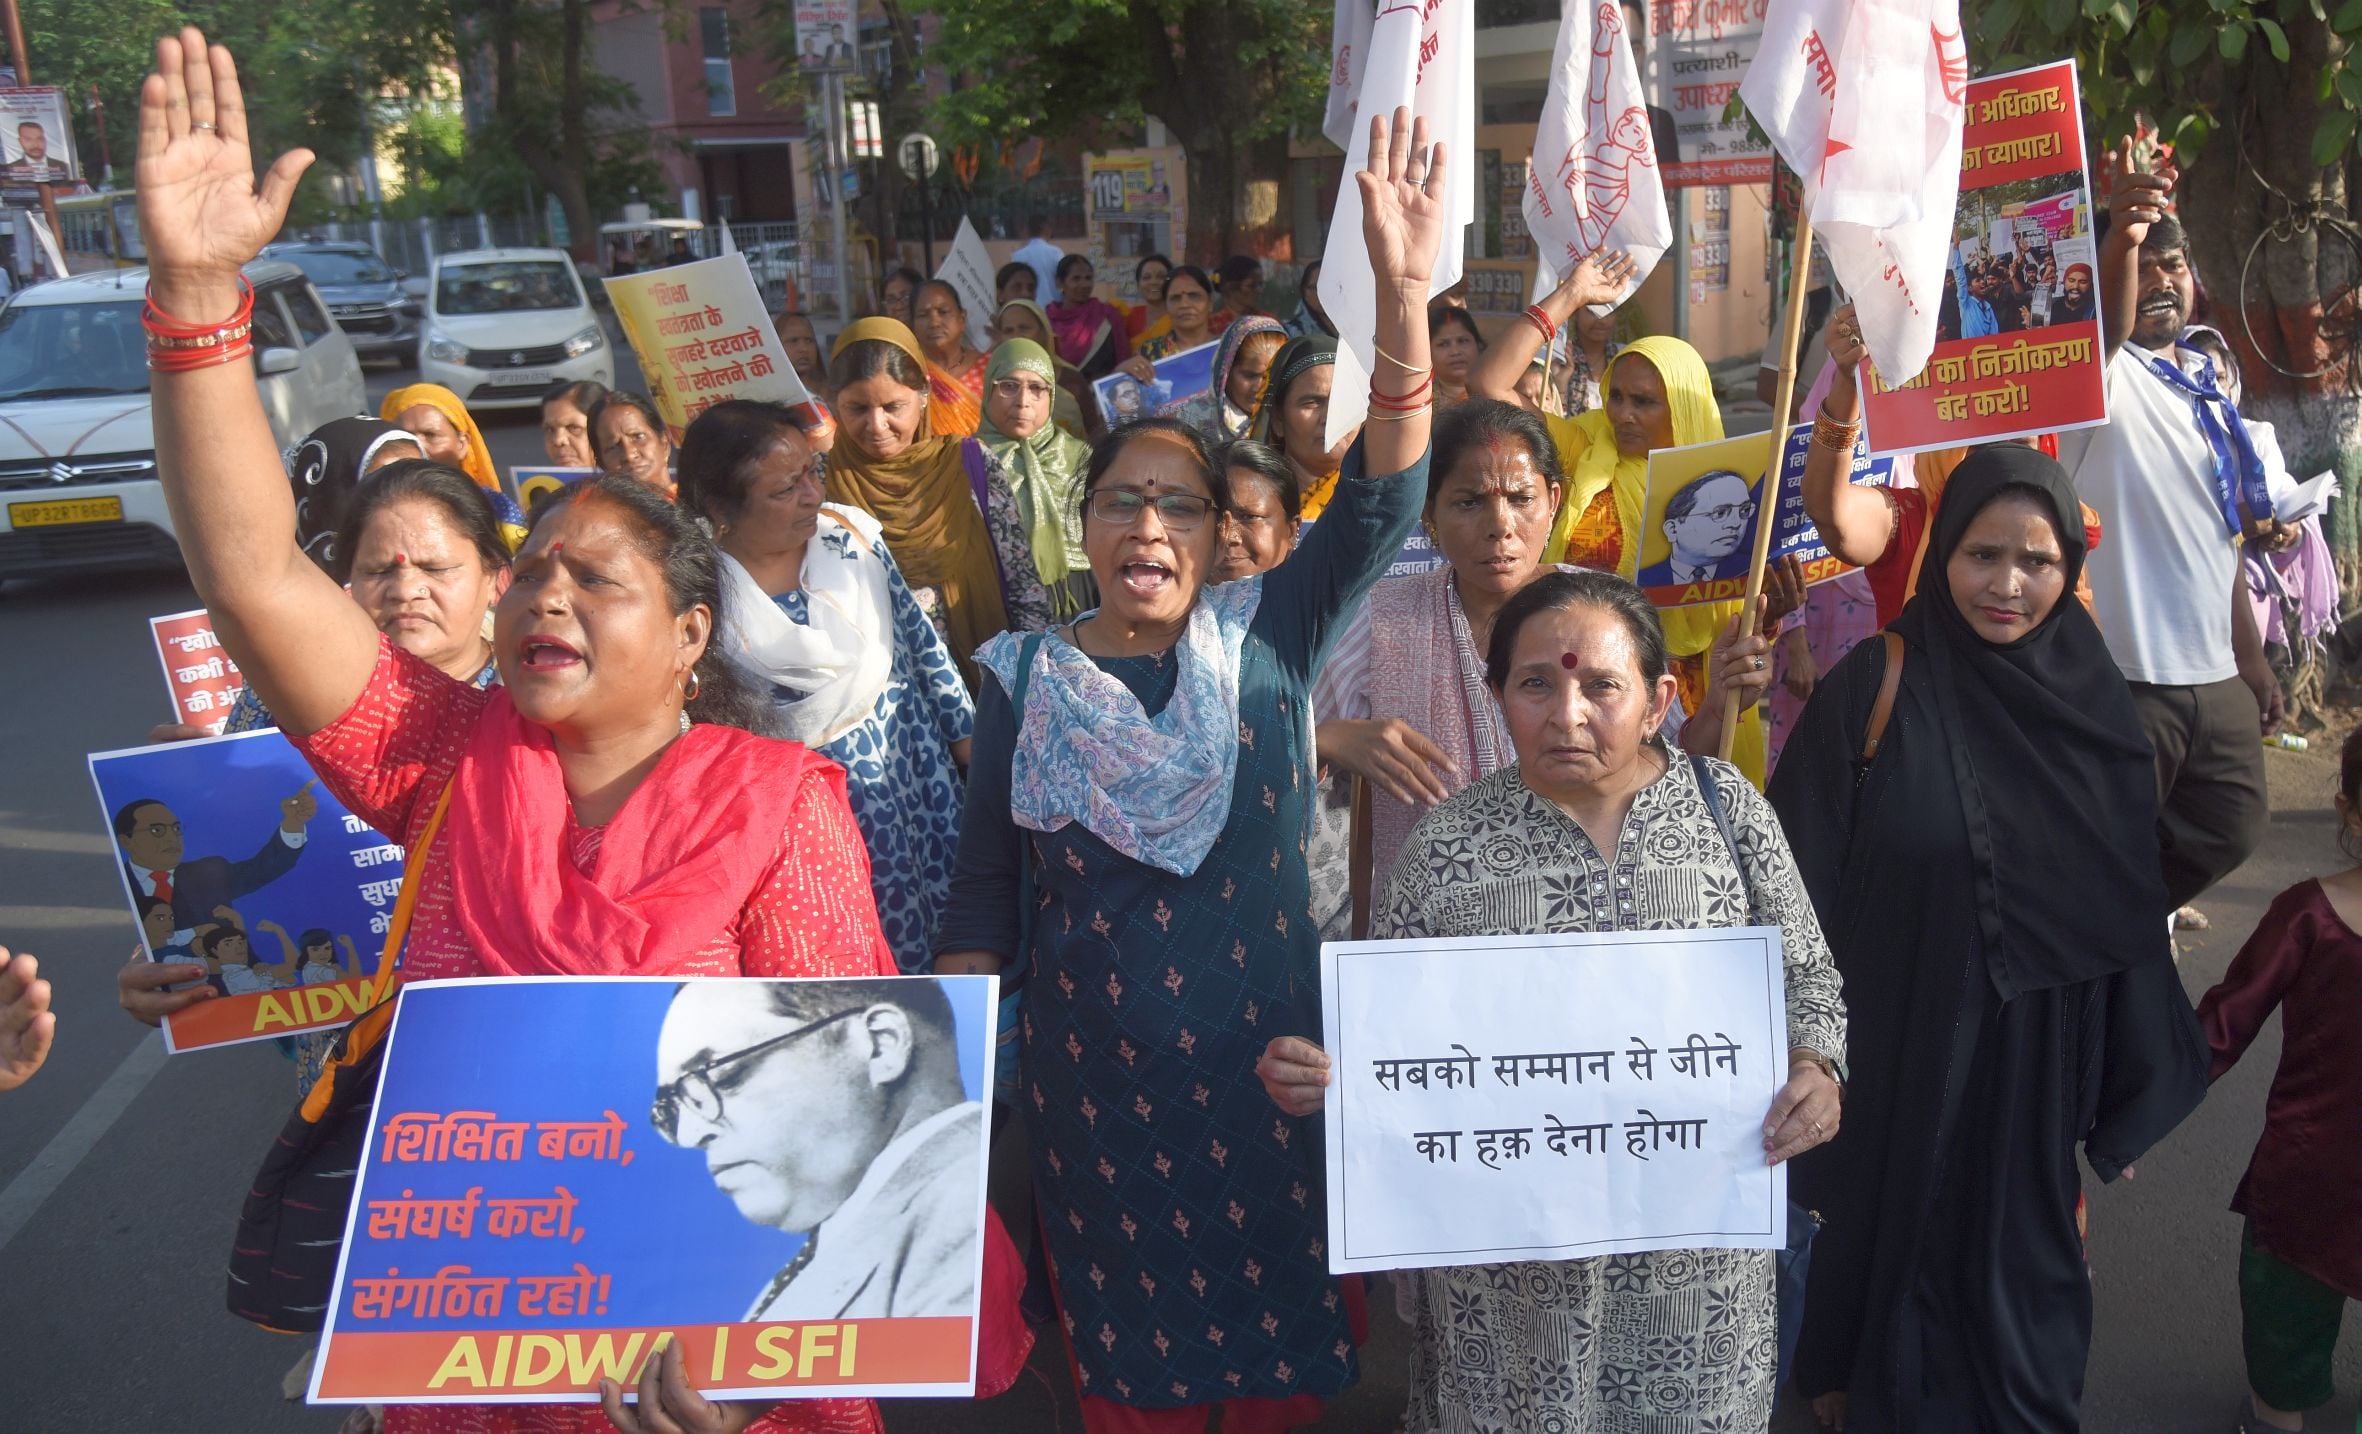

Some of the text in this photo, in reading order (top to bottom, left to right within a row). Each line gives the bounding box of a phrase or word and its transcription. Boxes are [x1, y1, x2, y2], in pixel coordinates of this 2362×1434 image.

[1980, 86, 2067, 124] अधिकार,
[1984, 131, 2062, 166] व्यापार।
[1095, 173, 1123, 208] 119
[704, 304, 724, 327] के
[690, 360, 748, 391] खोलने
[745, 353, 775, 377] की
[1932, 356, 1968, 384] का
[1969, 337, 2093, 381] निजीकरण
[1934, 379, 2031, 422] बंद करो!
[175, 656, 224, 683] कभी
[184, 689, 215, 713] की
[1373, 1032, 1742, 1091] सबको सम्मान से जीने
[381, 1110, 635, 1167] शिक्षित बनो,
[1413, 1108, 1708, 1171] का हक़ देना होगा
[366, 1186, 586, 1244] संघर्ष करो,
[351, 1263, 612, 1319] संगठित रहो!
[746, 1323, 859, 1379] SFI
